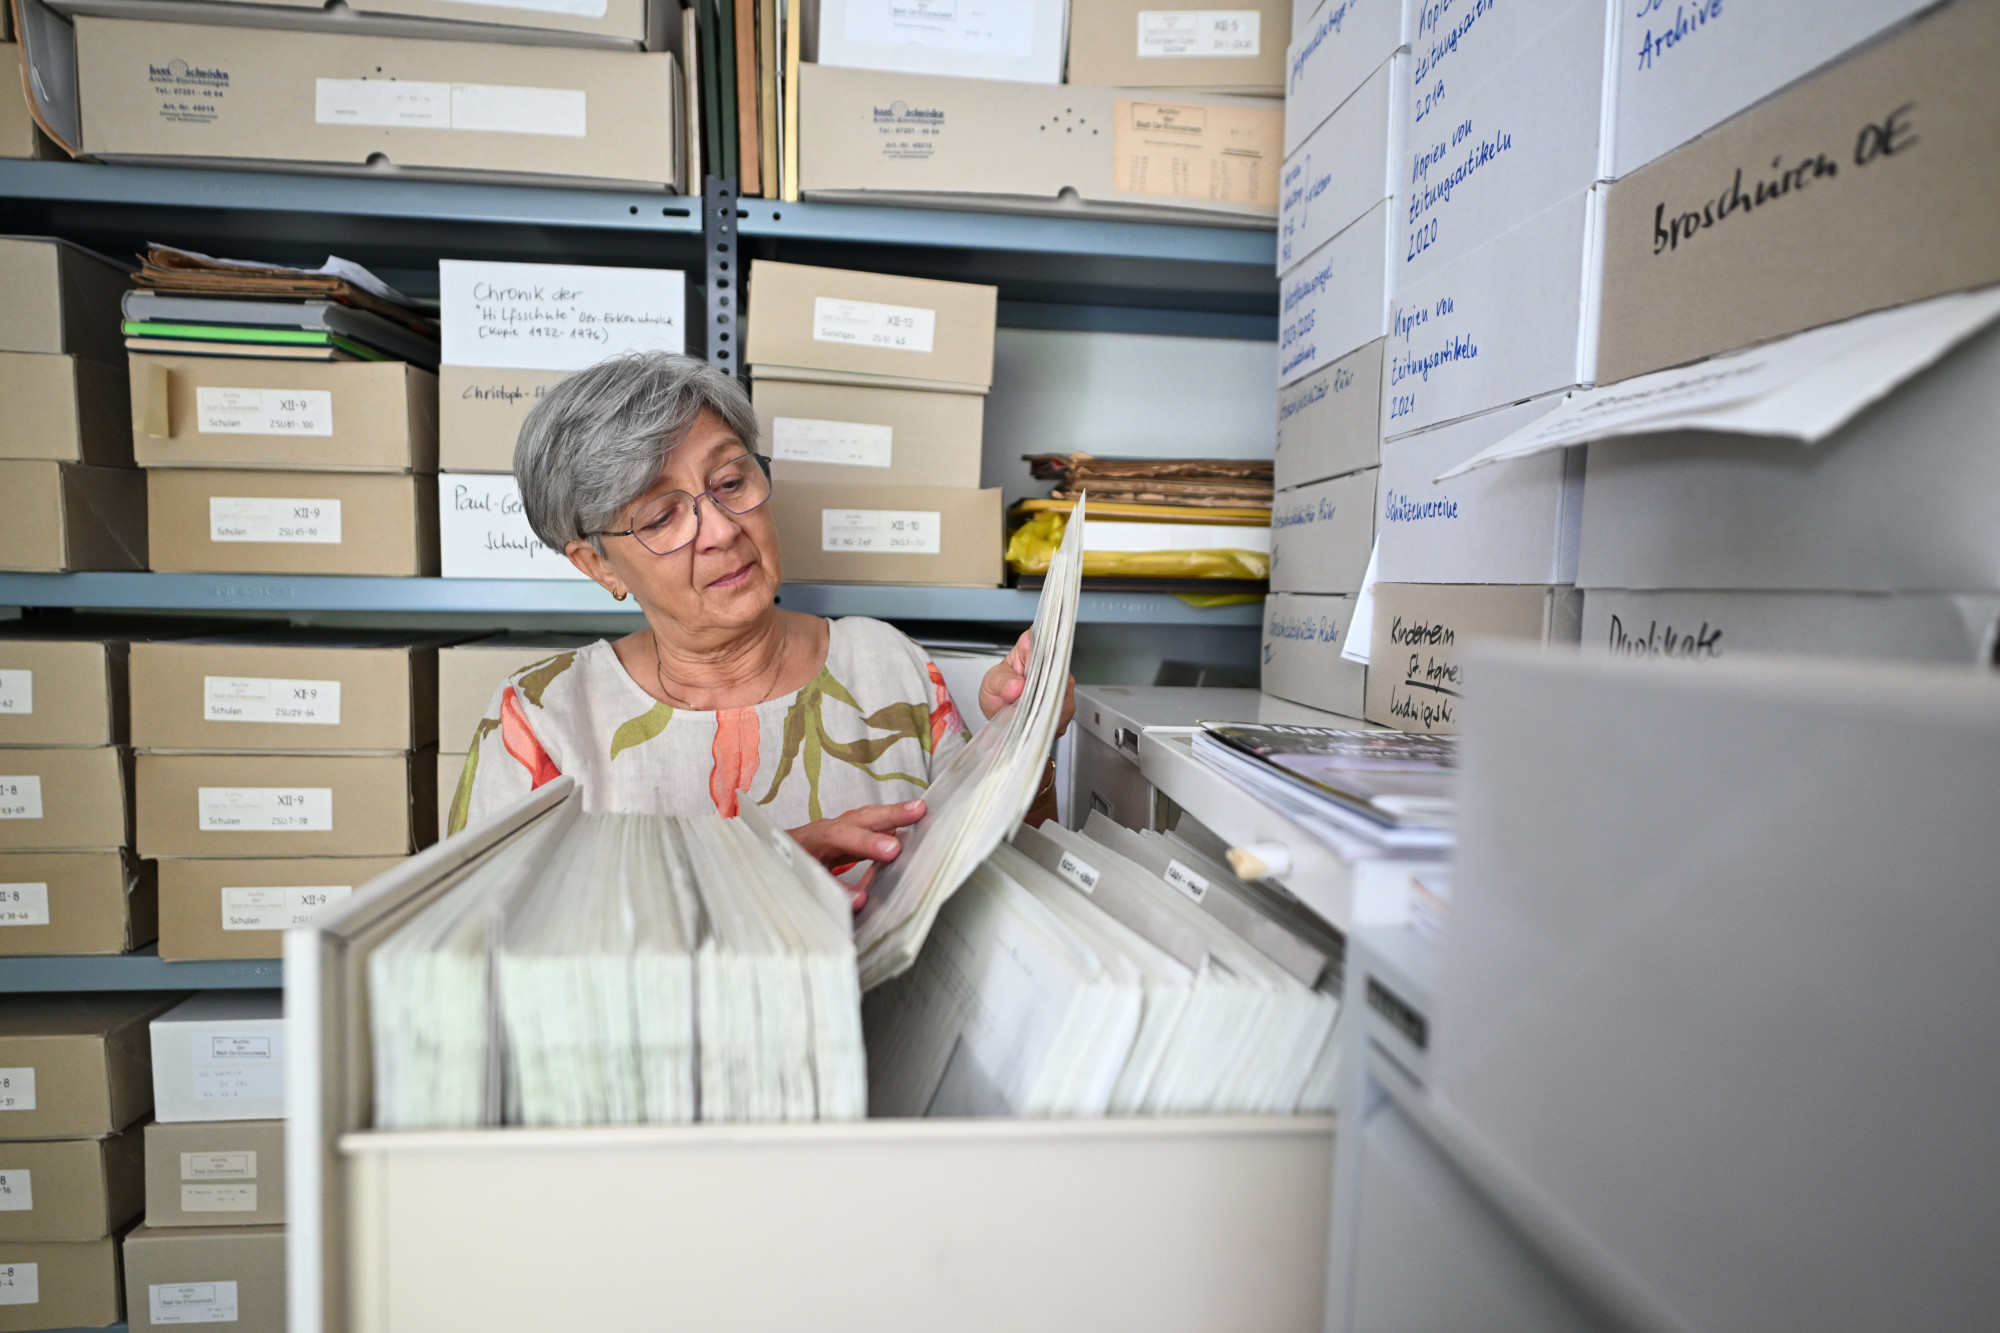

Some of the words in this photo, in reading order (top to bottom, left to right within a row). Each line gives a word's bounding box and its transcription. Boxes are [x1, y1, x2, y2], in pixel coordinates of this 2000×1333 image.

[1419, 0, 1456, 40] Kopie
[1415, 0, 1493, 85] Zeitungsarti
[1416, 79, 1445, 122] 2019
[1413, 142, 1446, 184] Kopien
[1453, 119, 1472, 148] von
[1410, 129, 1512, 225] Zeitungsartikeln
[1407, 217, 1437, 263] 2020
[473, 282, 545, 301] Chronik
[552, 286, 583, 301] der
[1394, 304, 1428, 343] Kopien
[1437, 297, 1454, 317] von
[1392, 333, 1478, 386] Zeitungsartikeln
[280, 399, 307, 411] XII-9
[1391, 393, 1415, 419] 2021
[209, 418, 241, 427] Schulen
[293, 507, 320, 518] XII-9
[1386, 488, 1458, 522] Schützenvereine
[217, 527, 247, 535] Schulen
[211, 705, 242, 715] Schulen
[278, 795, 304, 806] XII-9
[209, 816, 241, 825] Schulen
[301, 895, 326, 906] XII-9
[230, 916, 260, 925] Schulen
